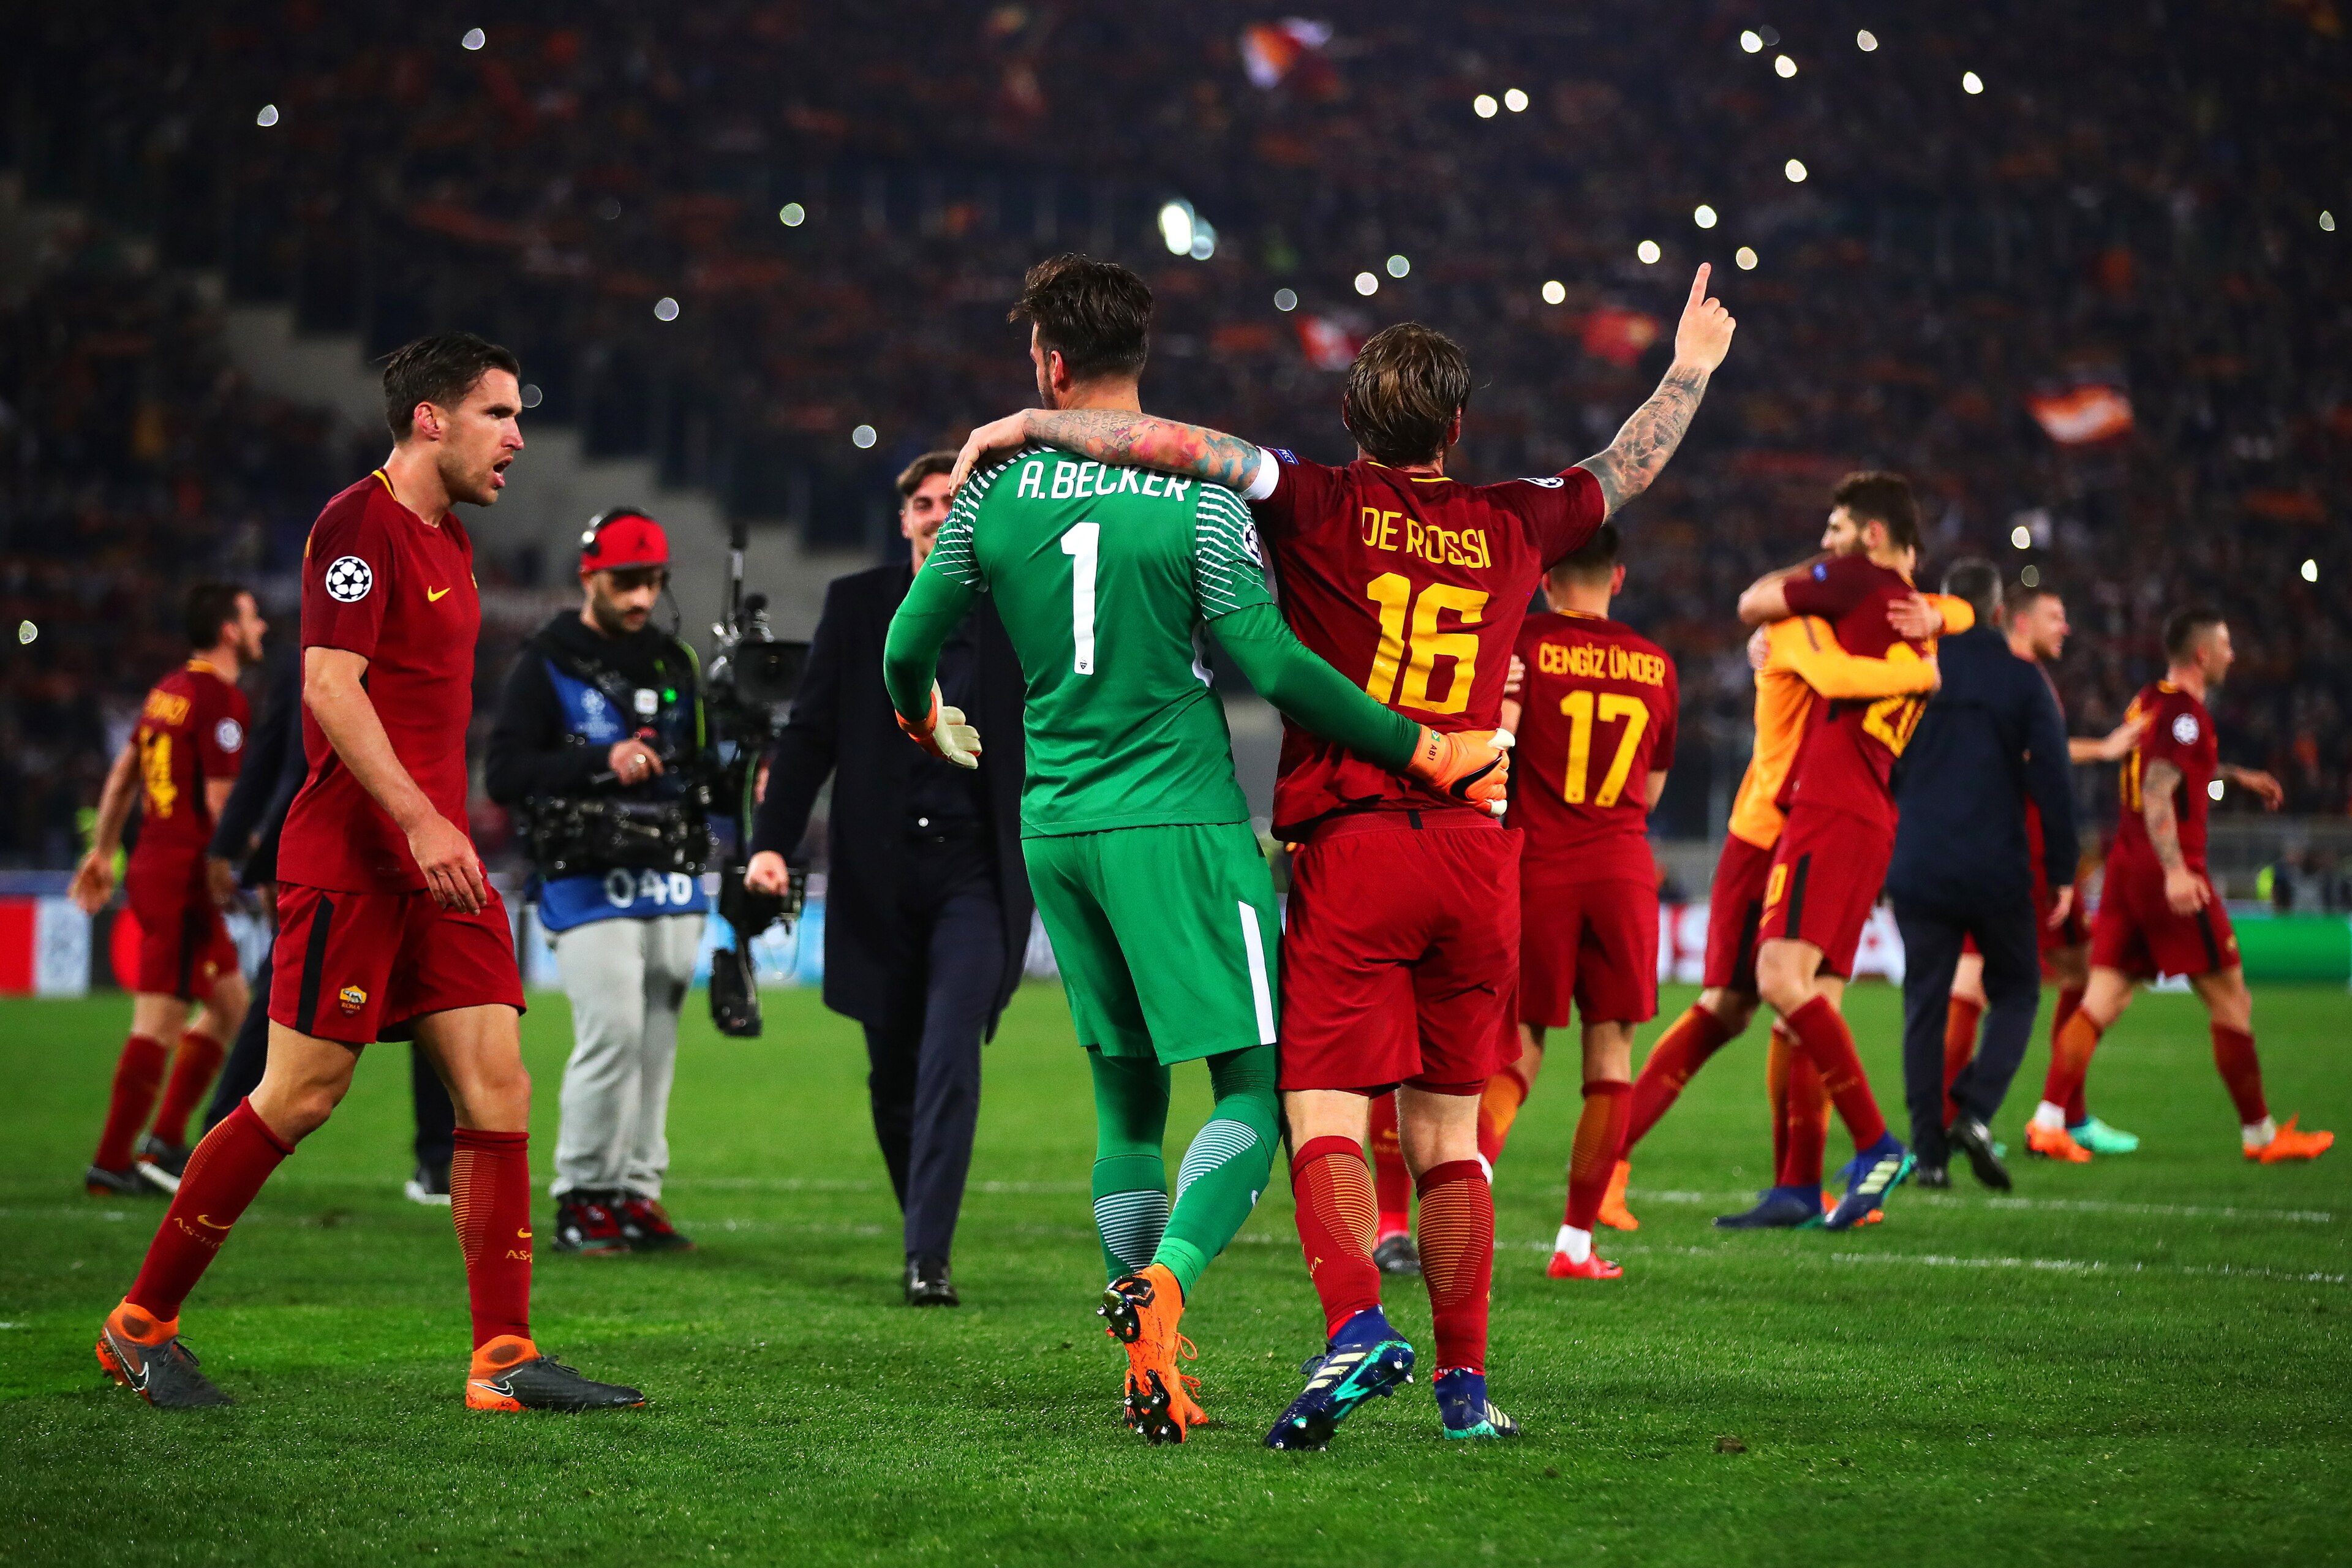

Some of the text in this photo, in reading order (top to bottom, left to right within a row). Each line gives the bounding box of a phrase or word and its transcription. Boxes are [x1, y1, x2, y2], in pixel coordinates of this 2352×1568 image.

[1017, 460, 1192, 502] A.BECKER
[1362, 507, 1491, 568] DE ROSSI
[1060, 522, 1101, 675] 1
[1365, 571, 1490, 715] 16
[1560, 690, 1649, 808] 17
